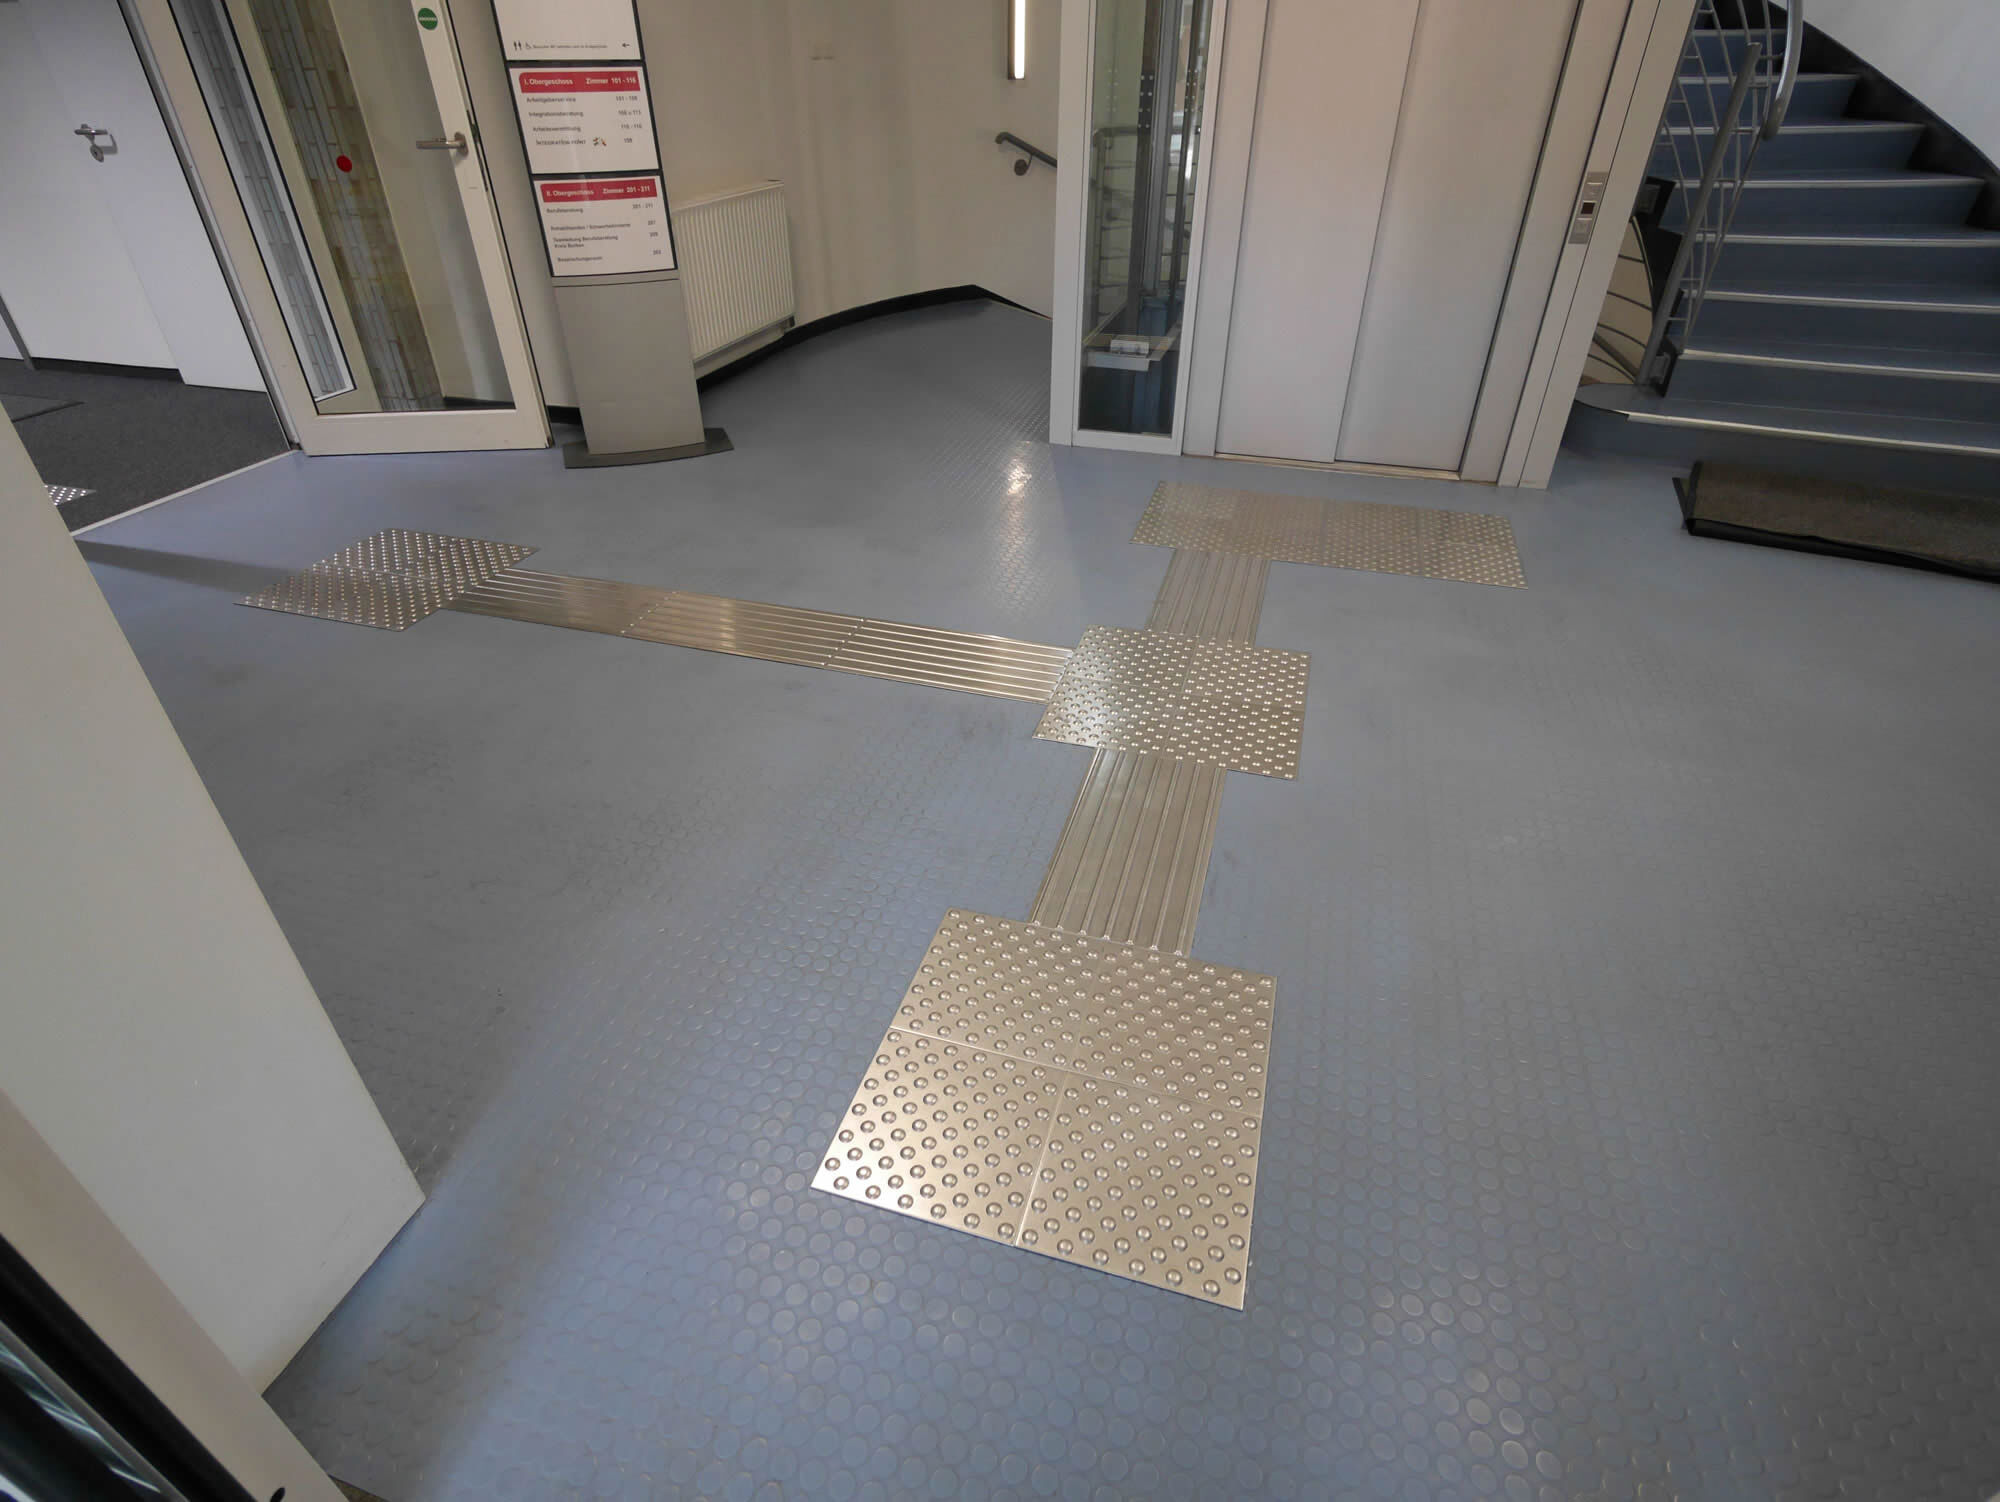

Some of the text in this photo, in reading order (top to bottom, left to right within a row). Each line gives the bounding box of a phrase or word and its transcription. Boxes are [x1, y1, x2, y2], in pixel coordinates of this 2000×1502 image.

[529, 78, 574, 87] Obergeschoss
[586, 77, 609, 85] Zimmer
[553, 189, 595, 198] Obergeschoss
[602, 187, 624, 195] Zimmer
[641, 185, 651, 193] 211
